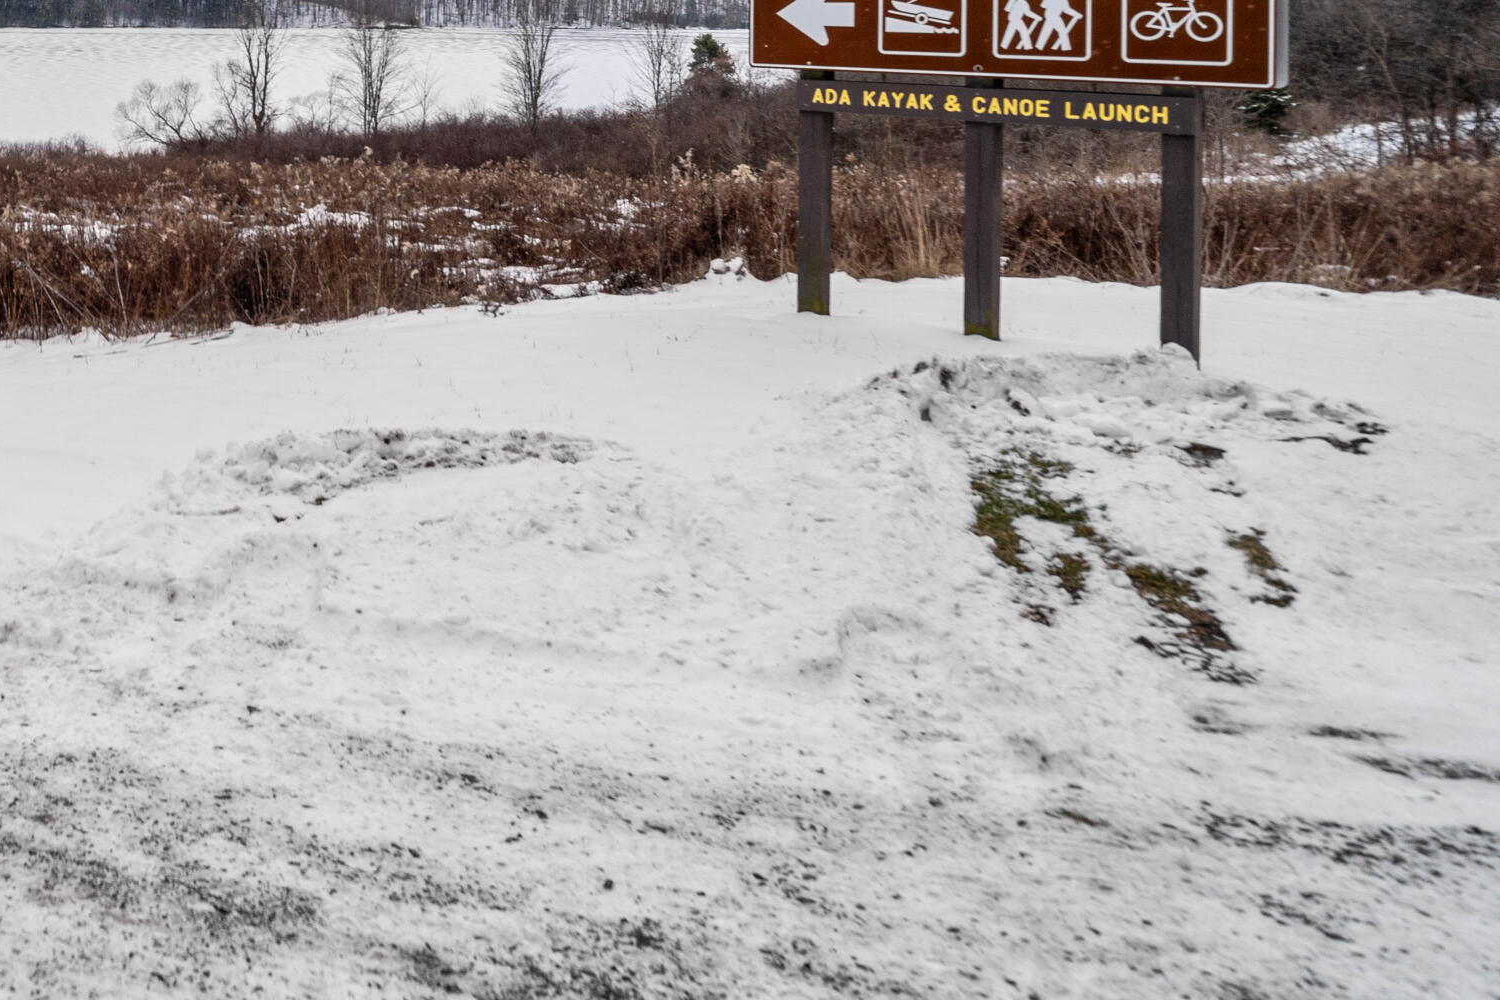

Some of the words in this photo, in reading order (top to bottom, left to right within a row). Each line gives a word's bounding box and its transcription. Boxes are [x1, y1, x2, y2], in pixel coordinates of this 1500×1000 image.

[811, 87, 852, 105] ADA
[862, 90, 934, 111] KAYAK
[943, 94, 962, 113] &
[971, 96, 1051, 118] CANOE
[1064, 101, 1169, 125] LAUNCH
